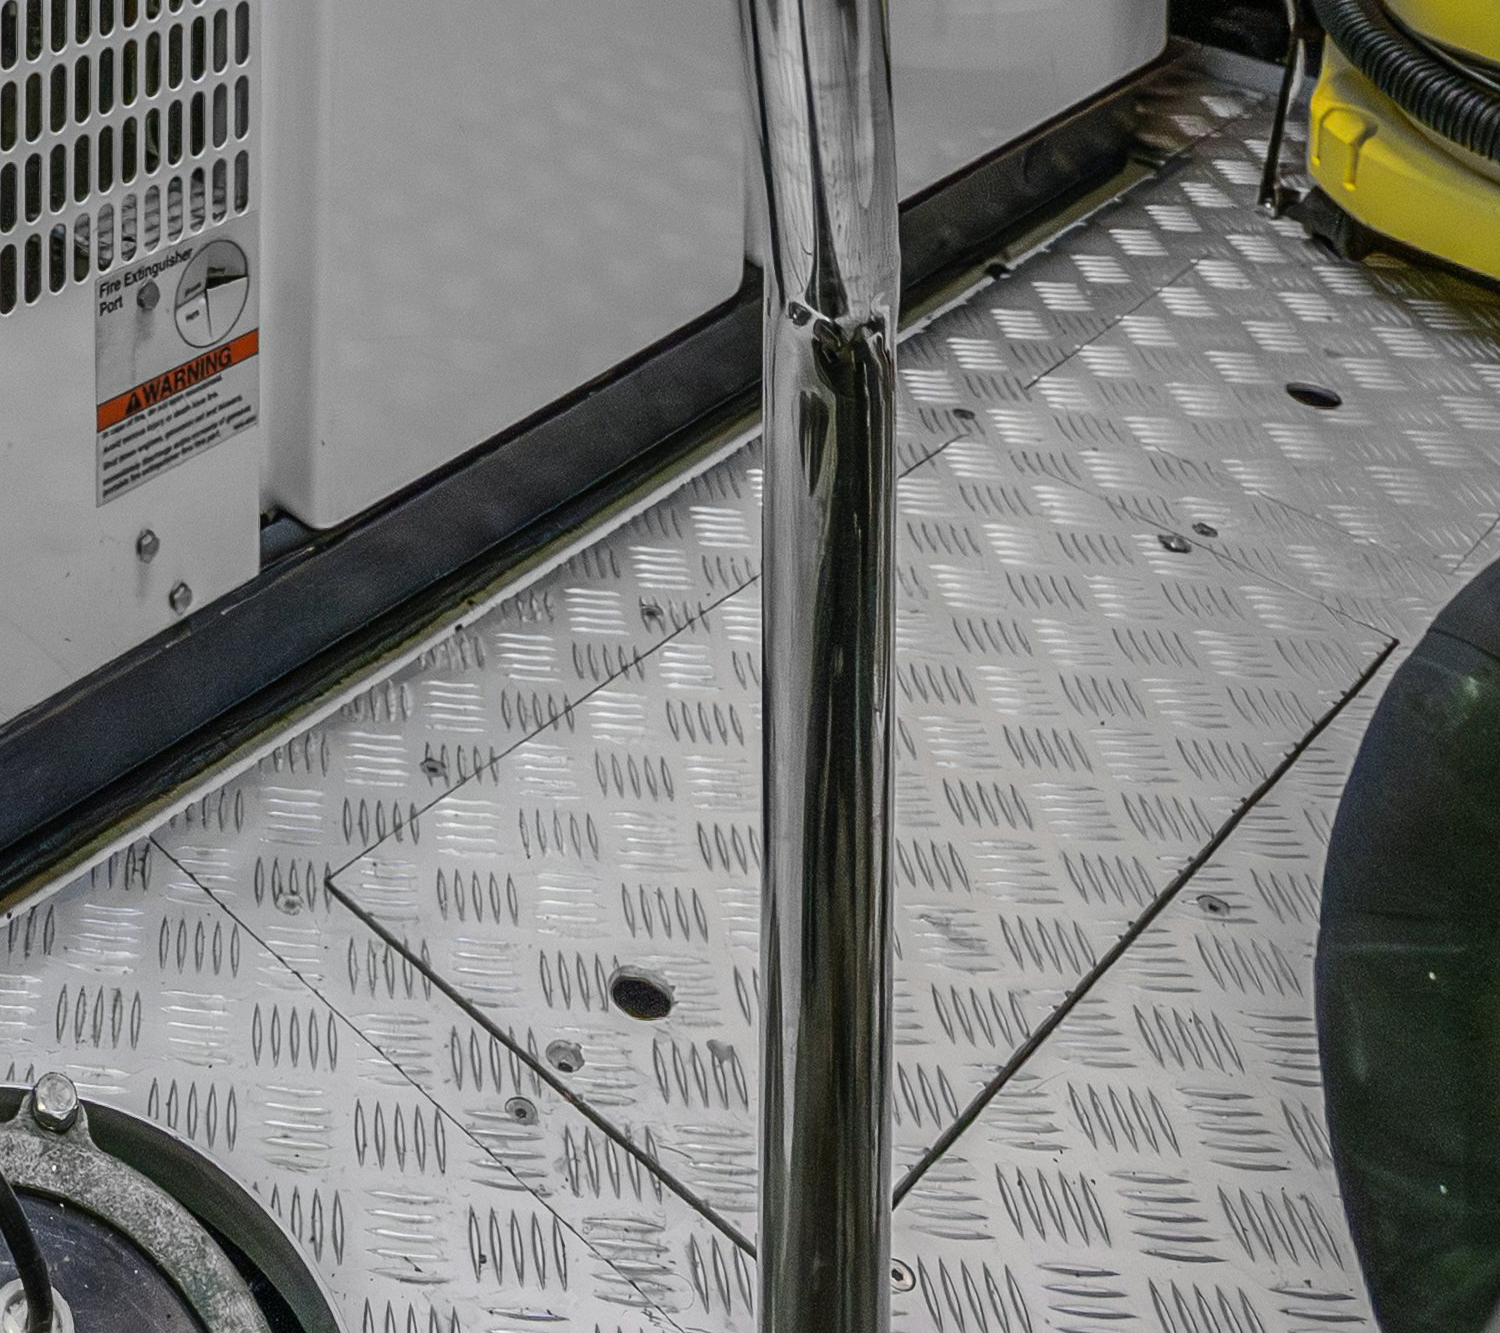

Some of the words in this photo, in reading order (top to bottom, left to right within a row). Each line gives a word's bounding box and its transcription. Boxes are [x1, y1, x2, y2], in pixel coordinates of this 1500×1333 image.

[100, 280, 122, 299] Fire
[124, 248, 194, 288] Extinguisher
[100, 295, 123, 317] Port
[141, 346, 232, 405] WARNING
